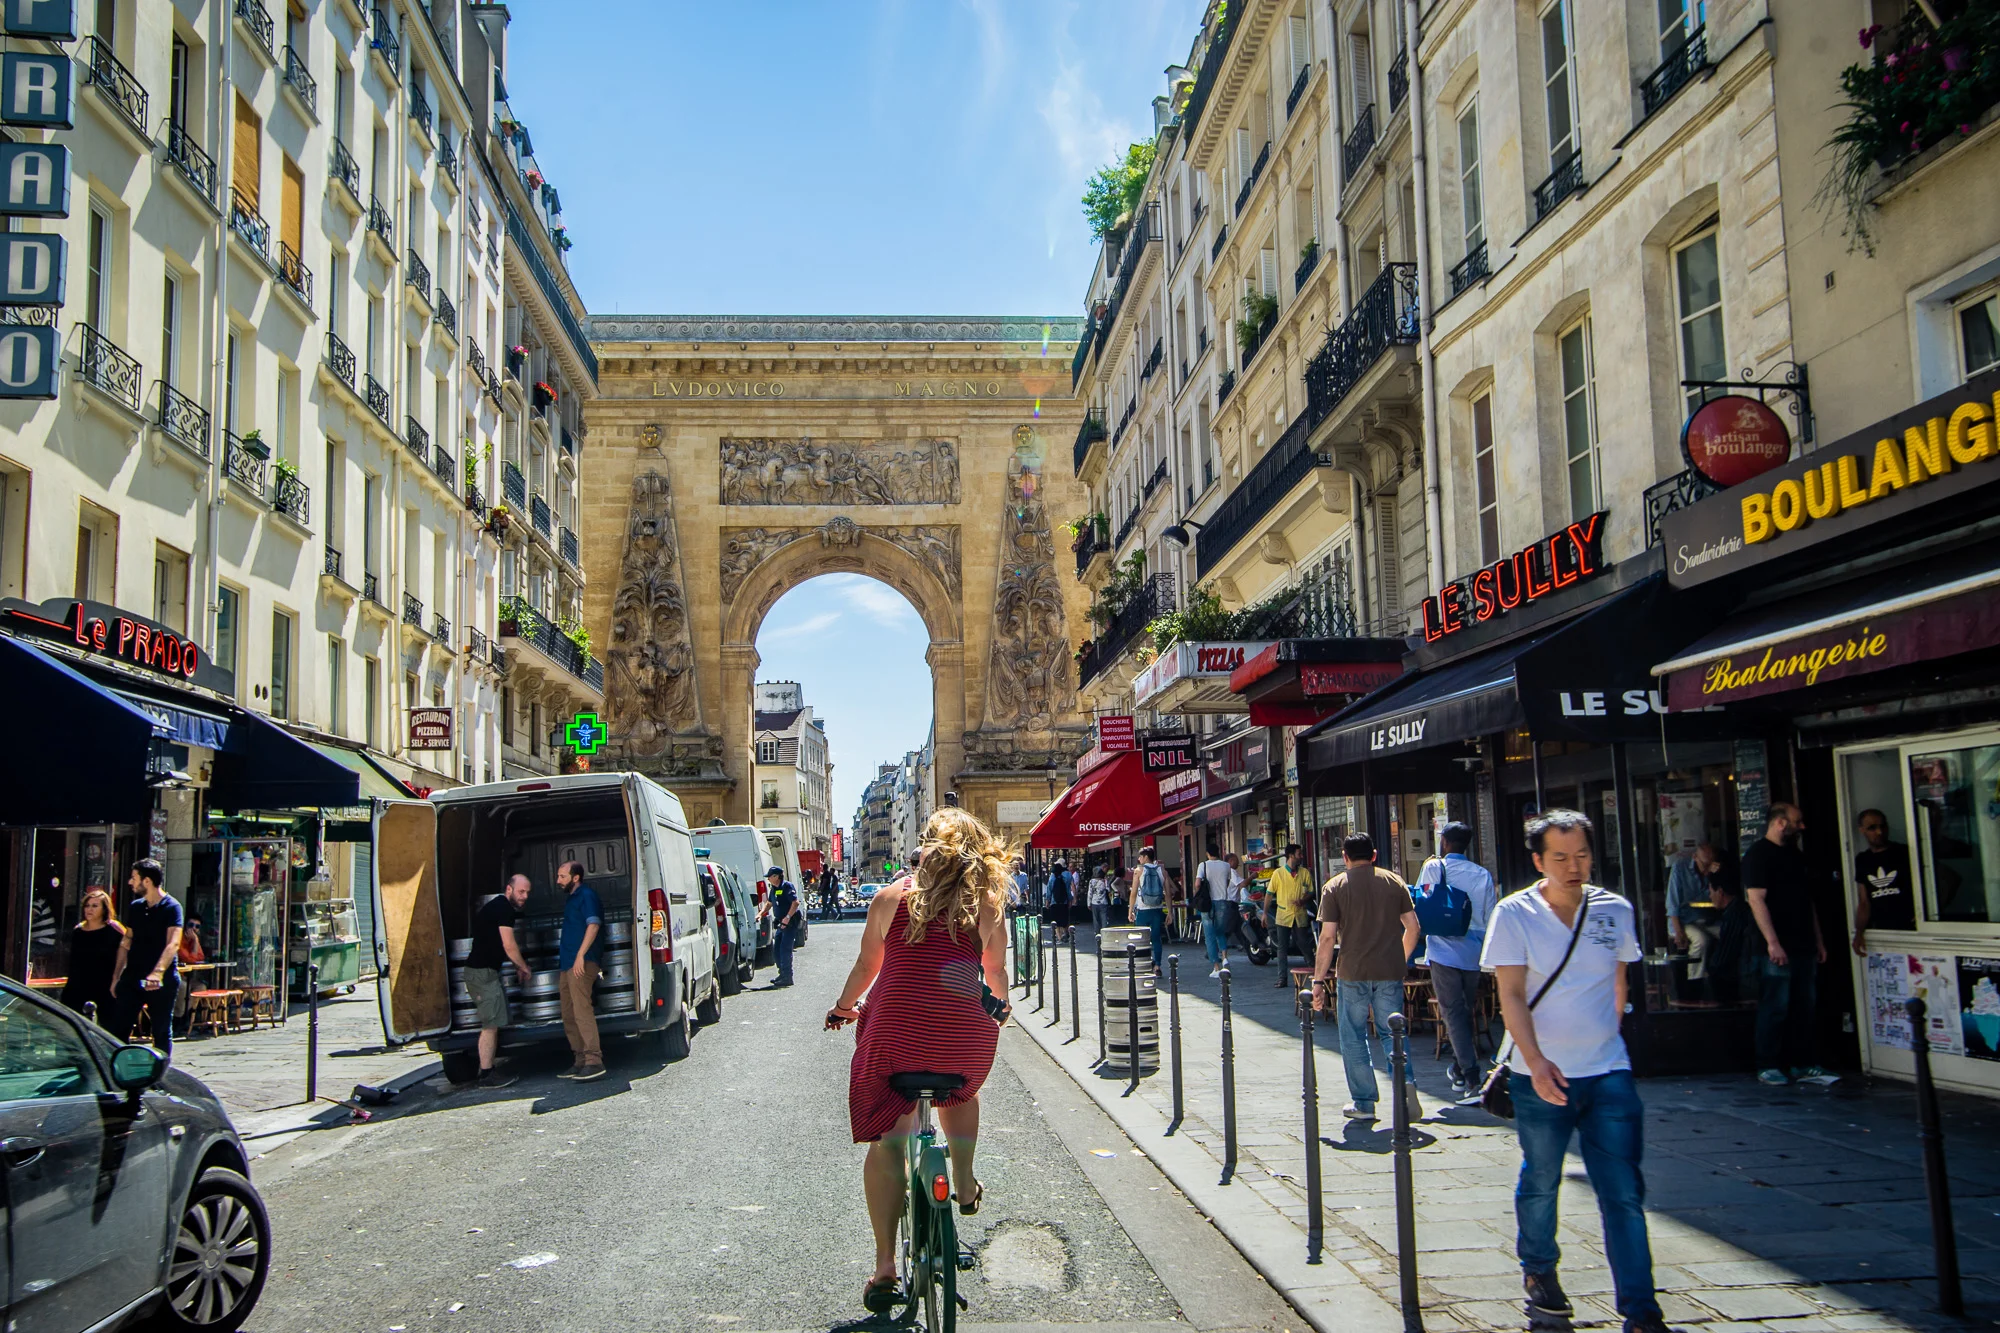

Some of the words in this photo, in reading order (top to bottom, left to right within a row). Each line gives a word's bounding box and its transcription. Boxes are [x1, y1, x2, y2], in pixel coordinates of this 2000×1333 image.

[652, 381, 785, 397] LVDOVICO
[894, 381, 1002, 396] MAGNO
[1704, 440, 1785, 459] boulanger
[1714, 430, 1760, 444] artisan
[1741, 386, 2000, 545] BOULANG
[1673, 535, 1742, 576] Sandwicherie
[1422, 584, 1461, 643] LE
[1473, 514, 1599, 622] SULLY
[76, 602, 107, 650] Le
[118, 616, 198, 678] PRADO
[1197, 645, 1245, 673] PIZZAS
[1702, 627, 1887, 694] Boulangerie
[1560, 692, 1606, 717] LE
[411, 711, 450, 728] RESTAURANT
[417, 726, 444, 736] PIZZERIA
[1371, 728, 1385, 751] LE
[1388, 718, 1426, 748] SULLY
[1148, 750, 1192, 767] NIL
[1871, 887, 1900, 899] adidas
